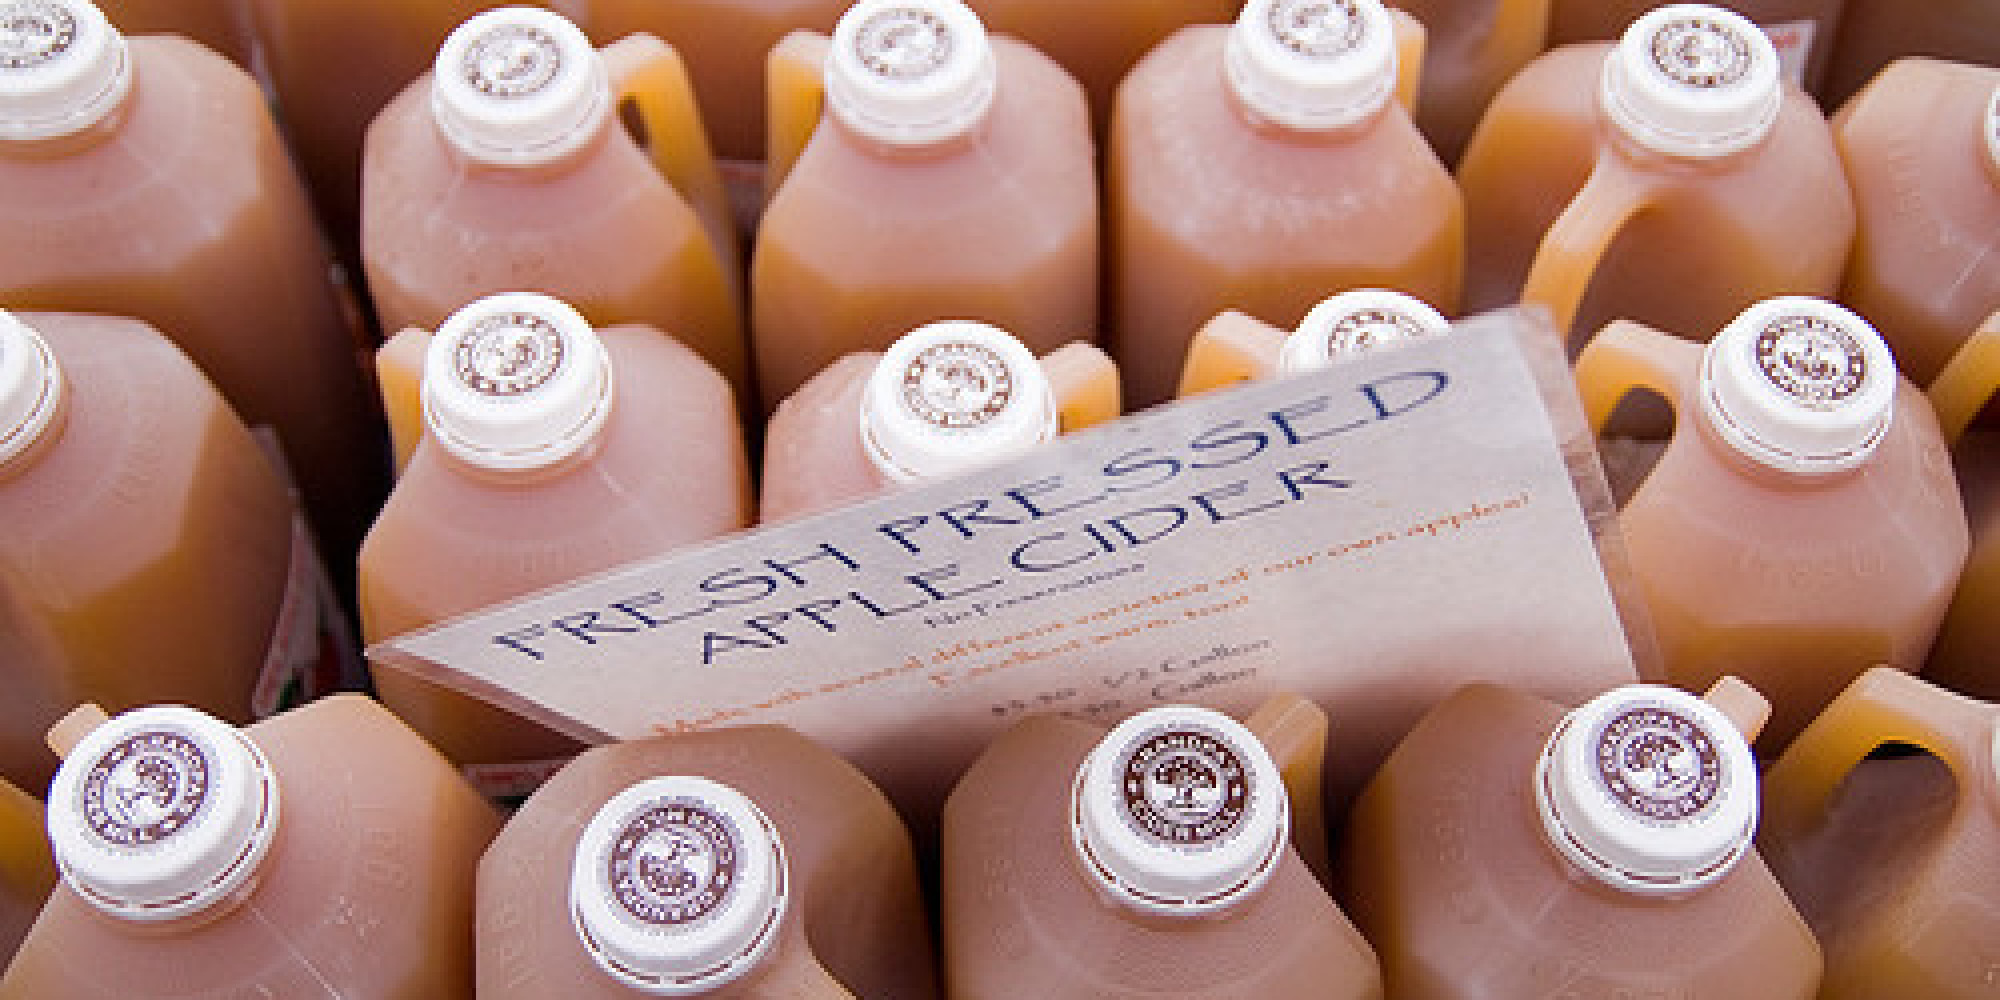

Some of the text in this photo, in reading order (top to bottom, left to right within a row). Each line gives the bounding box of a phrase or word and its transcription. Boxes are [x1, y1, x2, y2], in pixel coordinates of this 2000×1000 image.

[492, 543, 860, 660] FRESH
[877, 369, 1448, 553] PRESSED
[701, 461, 1356, 664] APPLE CIDER
[1215, 566, 1251, 591] of
